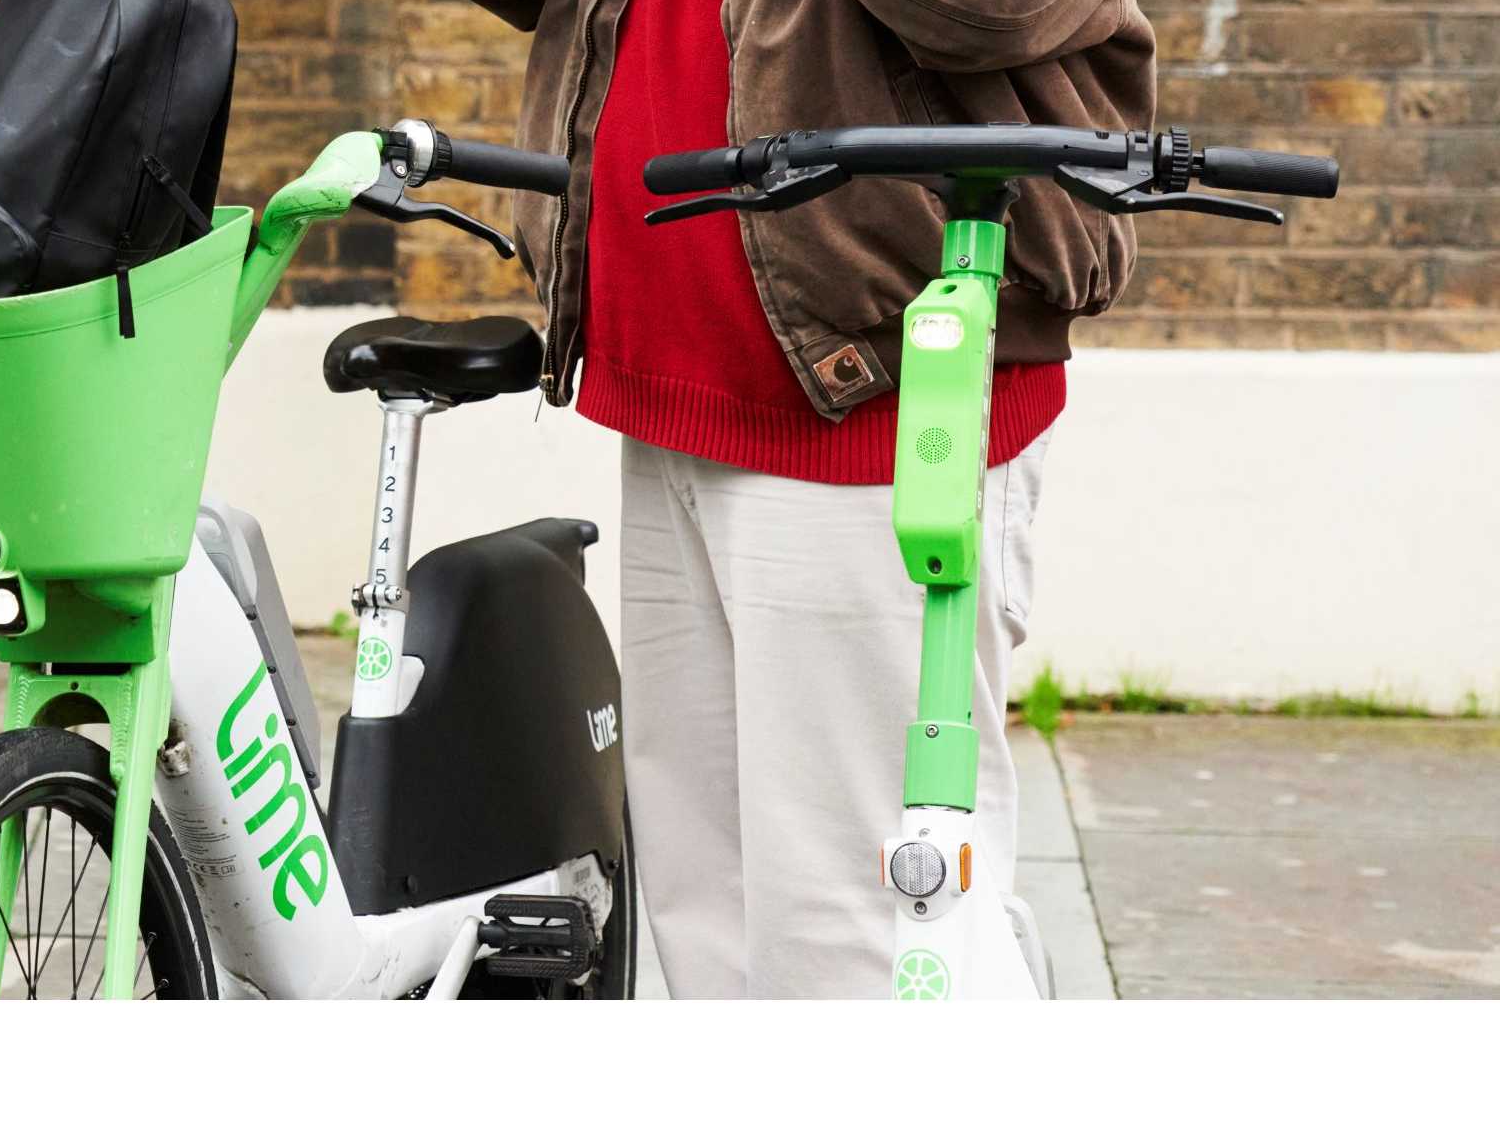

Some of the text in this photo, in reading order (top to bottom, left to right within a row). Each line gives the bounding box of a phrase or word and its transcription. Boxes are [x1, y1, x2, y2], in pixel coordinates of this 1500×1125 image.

[389, 445, 396, 460] 1
[384, 476, 396, 492] 2
[381, 507, 394, 523] 3
[378, 537, 390, 553] 4
[375, 568, 387, 584] 5
[586, 704, 617, 752] Lime
[216, 659, 329, 922] Lime
